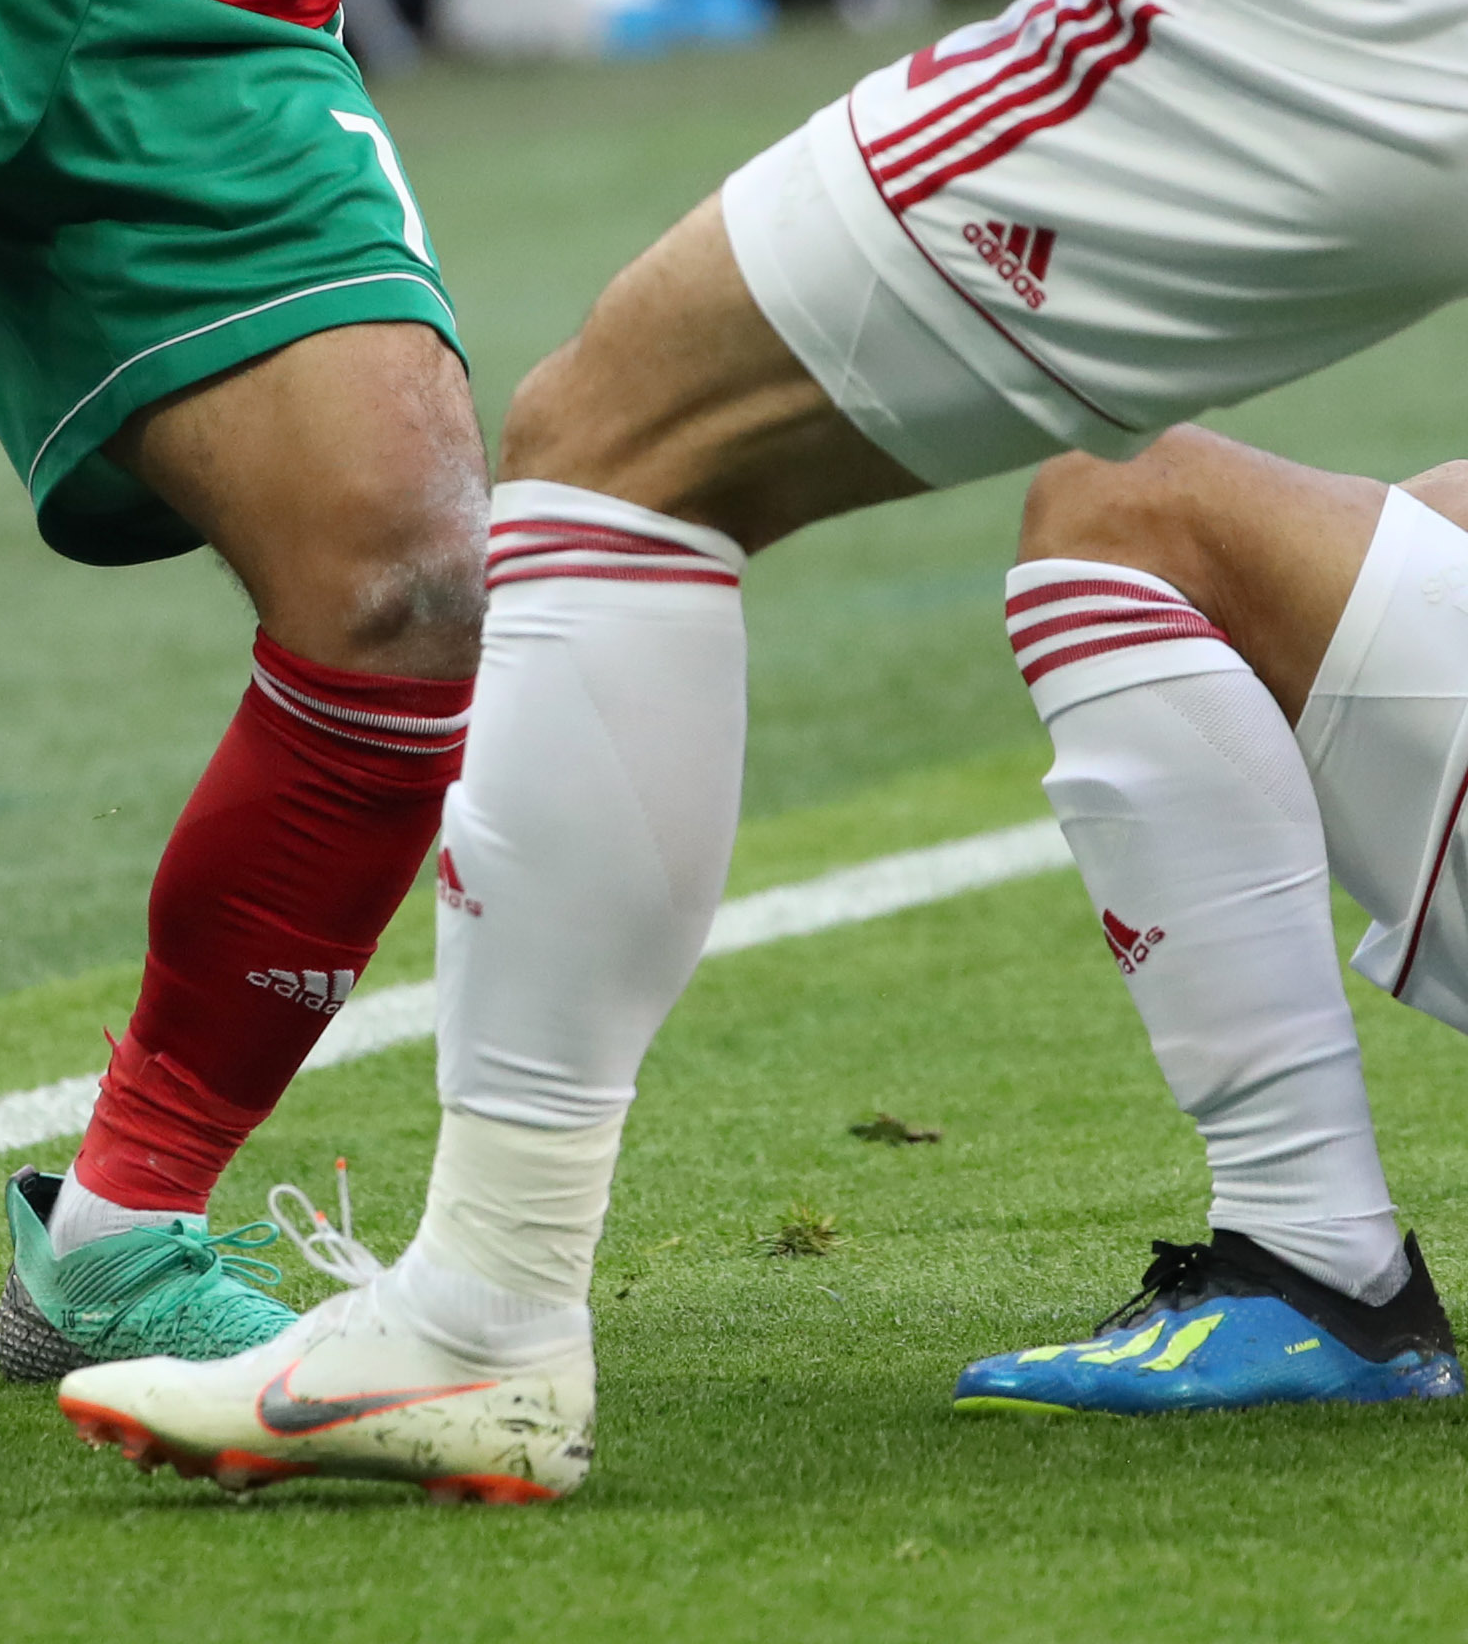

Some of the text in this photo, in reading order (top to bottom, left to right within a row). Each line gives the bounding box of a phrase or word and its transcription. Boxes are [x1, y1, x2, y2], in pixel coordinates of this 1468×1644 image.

[963, 223, 1045, 310] adidas
[245, 971, 344, 1014] adida
[60, 1309, 76, 1328] 10
